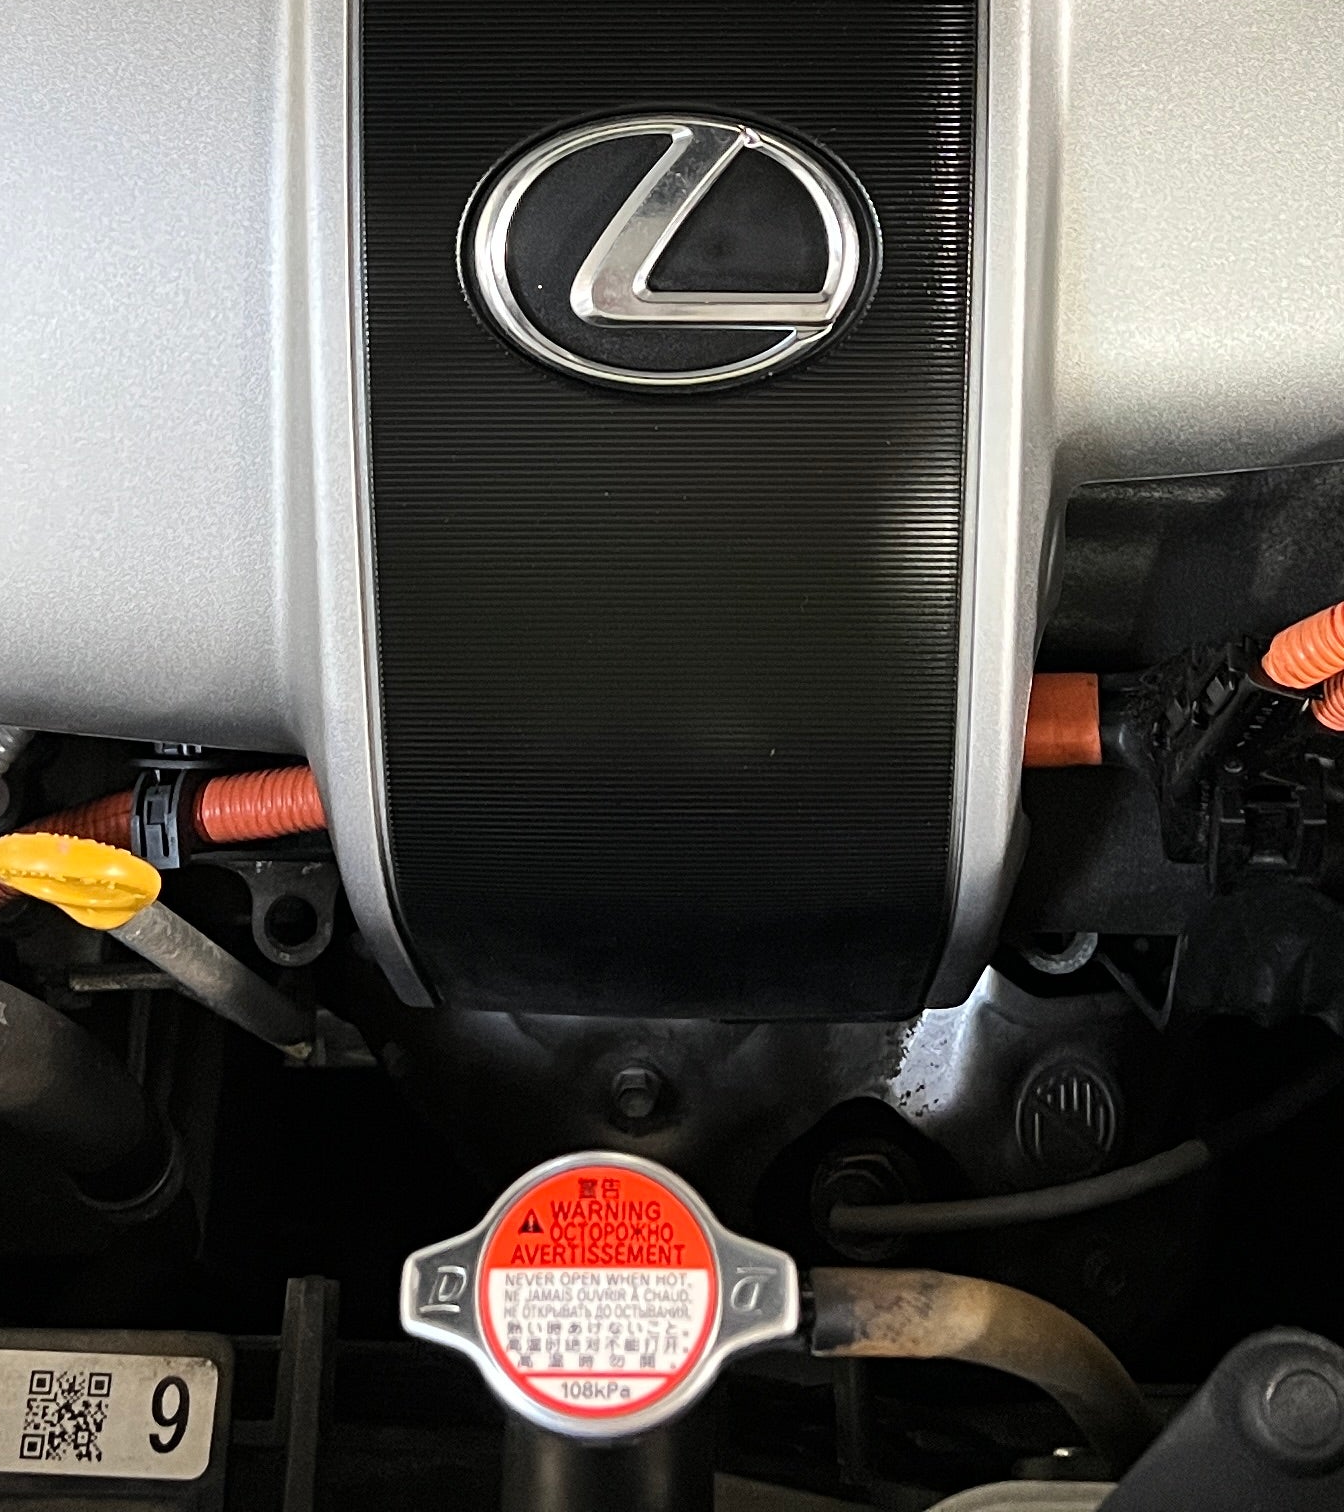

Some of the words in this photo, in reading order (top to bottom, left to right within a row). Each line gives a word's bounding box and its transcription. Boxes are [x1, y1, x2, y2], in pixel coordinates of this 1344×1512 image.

[550, 1201, 661, 1221] WARNING
[550, 1222, 674, 1242] ОСТОРОЖНО
[511, 1244, 686, 1265] AVERTISSEMENT
[505, 1272, 555, 1287] NEVER
[560, 1272, 601, 1287] OPEN
[606, 1272, 650, 1287] WHEN
[655, 1272, 693, 1288] HOT.
[505, 1289, 518, 1302] NE
[527, 1289, 574, 1302] JAMAIS
[577, 1289, 627, 1302] OUVRIR
[561, 1381, 631, 1400] 108kPa
[149, 1375, 191, 1455] 9
